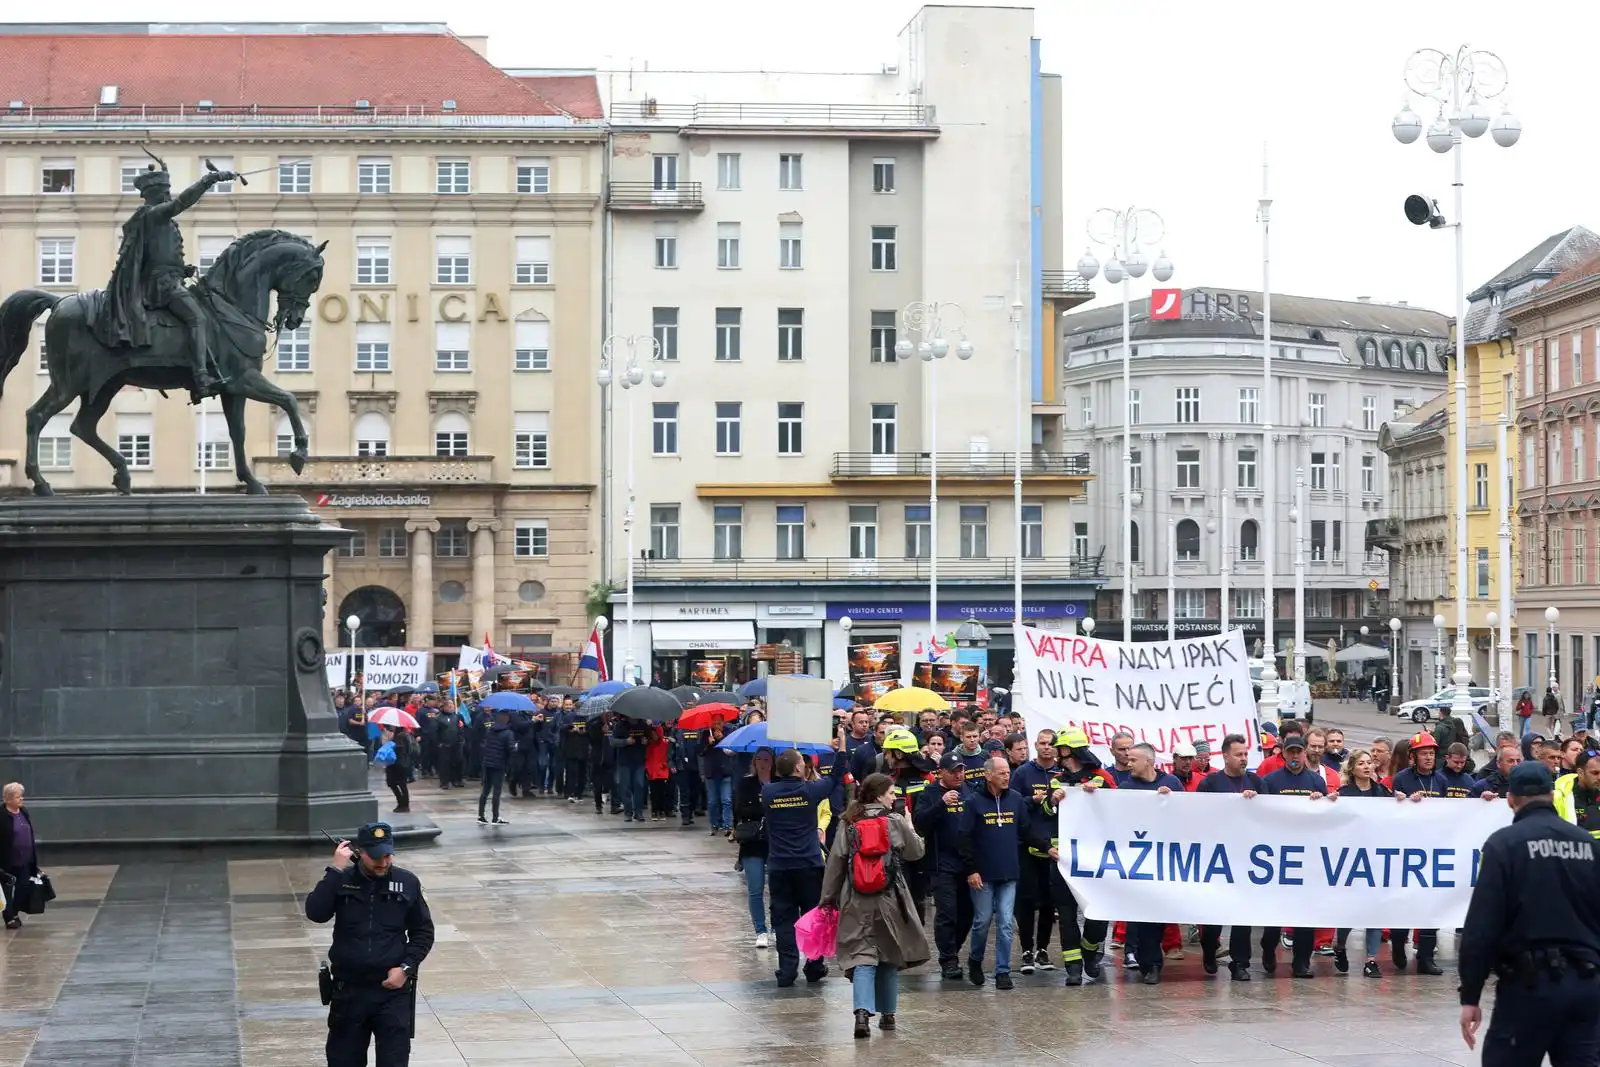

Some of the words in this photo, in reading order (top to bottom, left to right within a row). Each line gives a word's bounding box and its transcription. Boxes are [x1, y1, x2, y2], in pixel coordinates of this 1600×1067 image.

[396, 494, 430, 505] banka
[1026, 630, 1108, 669] VATRA
[1118, 646, 1176, 670] NAM
[1182, 639, 1238, 668] IPAK
[368, 654, 419, 667] SLAVKO
[366, 673, 419, 685] POMOZI!
[1037, 669, 1100, 707] NIJE
[1115, 674, 1235, 711] NAJVEĆI
[773, 796, 803, 804] HRVATSKI
[1526, 839, 1594, 861] POLICIJA
[1070, 830, 1235, 885] LAŽIMA
[1247, 844, 1305, 886] SE
[1320, 846, 1456, 888] VATRE
